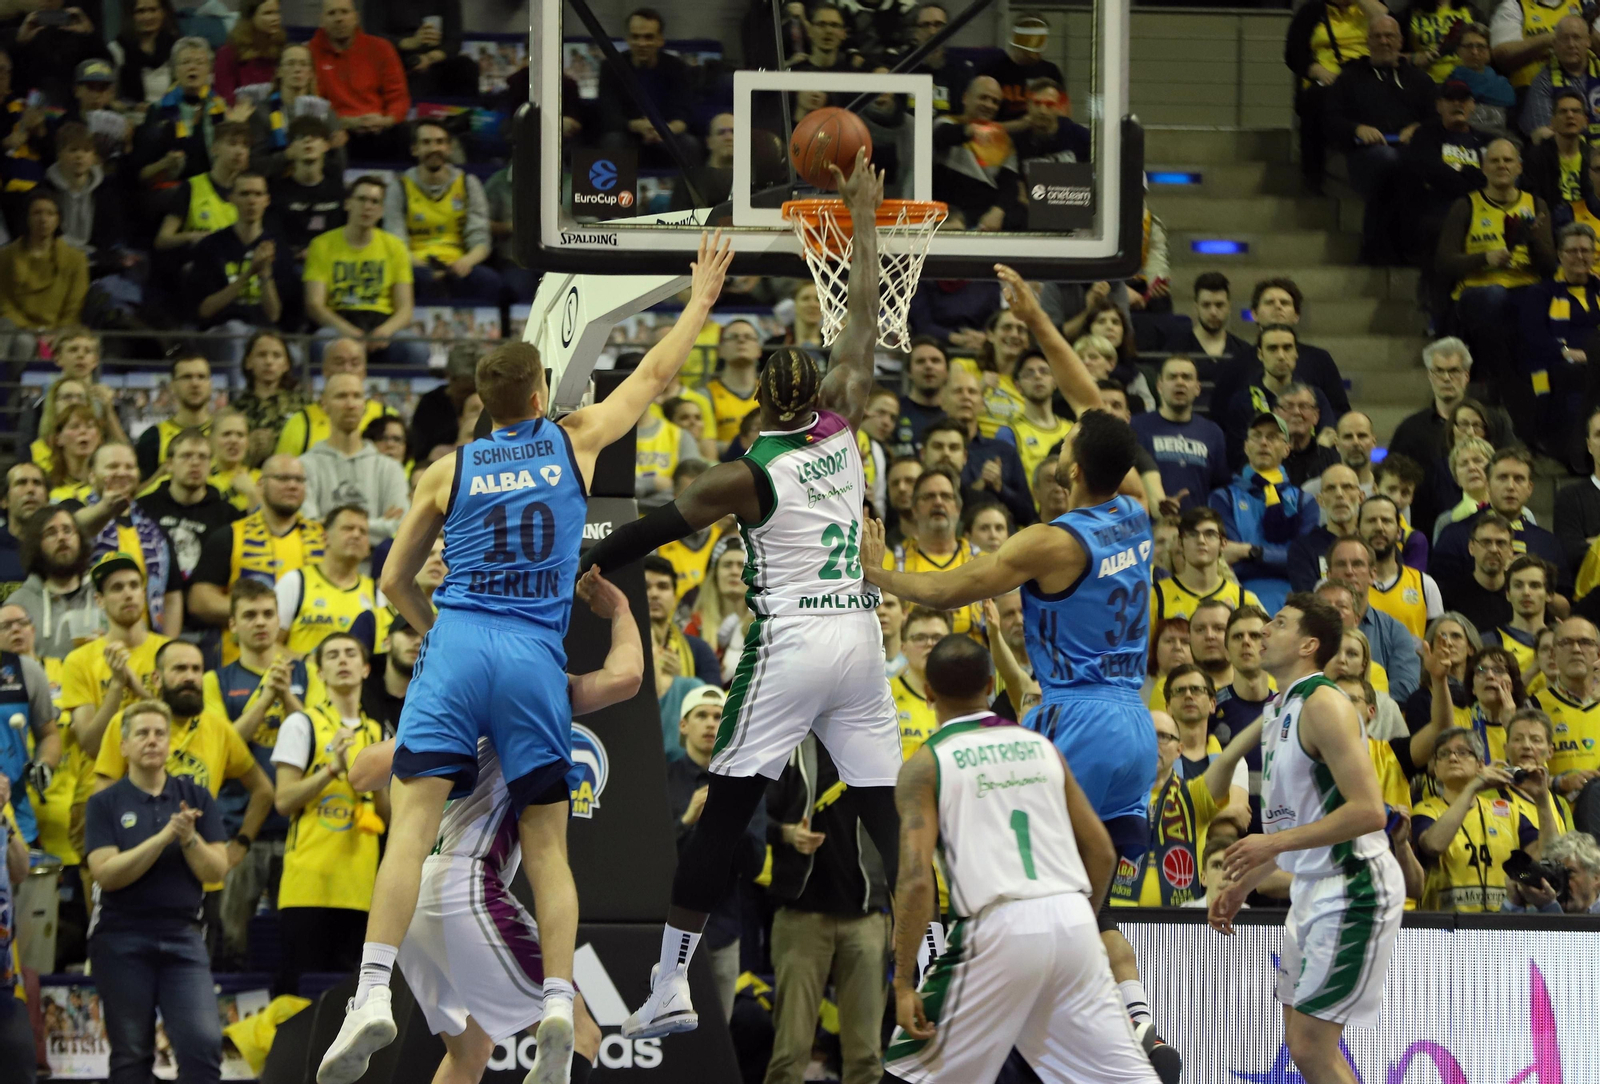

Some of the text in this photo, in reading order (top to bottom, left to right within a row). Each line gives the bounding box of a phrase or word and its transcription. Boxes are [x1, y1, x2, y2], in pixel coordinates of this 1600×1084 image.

[574, 193, 617, 206] EuroCup
[560, 232, 618, 247] SPALDING
[473, 440, 556, 467] SCHNEIDER
[1152, 433, 1209, 459] BERLIN
[796, 447, 849, 485] LESSORT
[469, 470, 537, 496] ALBA
[483, 501, 556, 564] 10
[817, 519, 863, 580] 26
[1098, 547, 1138, 579] ALBA
[468, 569, 560, 599] BERLIN
[1104, 580, 1148, 647] 32
[952, 740, 1047, 769] BOATRIGHT
[1010, 809, 1038, 880] 1
[1464, 843, 1493, 868] 24
